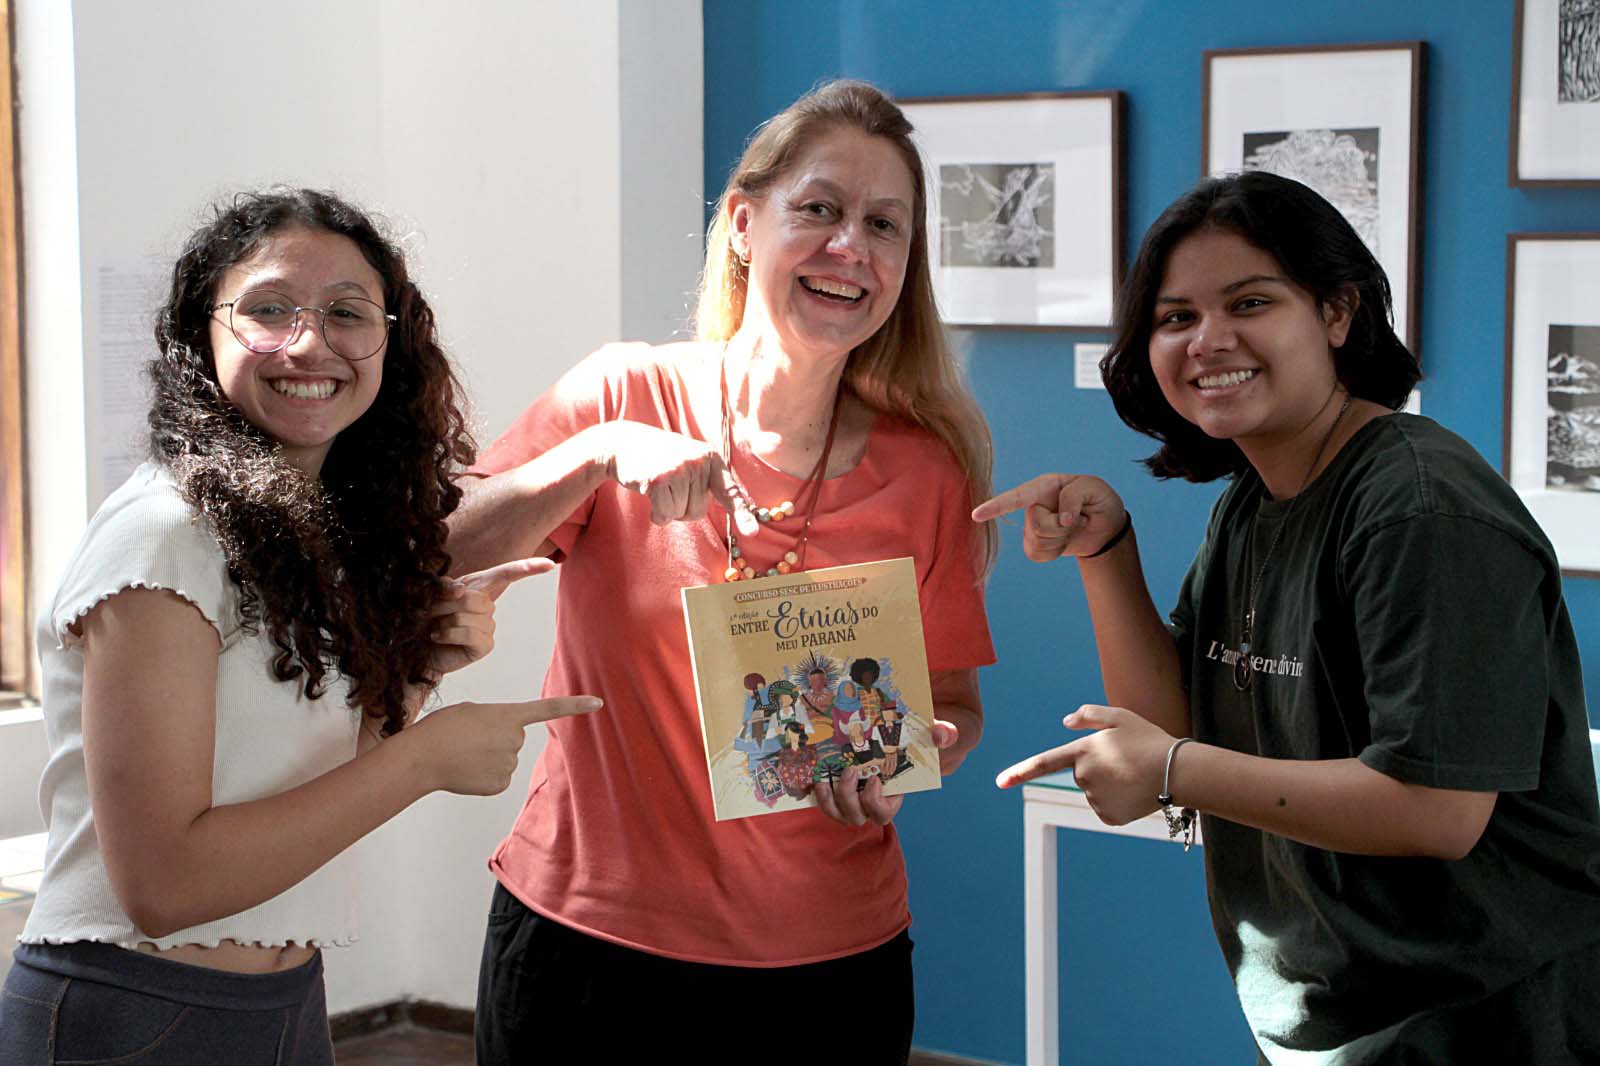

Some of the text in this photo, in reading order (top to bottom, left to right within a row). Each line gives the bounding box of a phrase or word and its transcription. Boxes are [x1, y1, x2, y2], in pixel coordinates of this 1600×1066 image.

[736, 577, 862, 602] CONCURSO SESC DE ILUSTRAÇÕES
[730, 600, 879, 639] ENTRE Etnias DO
[776, 625, 856, 652] MEU PARANÁ
